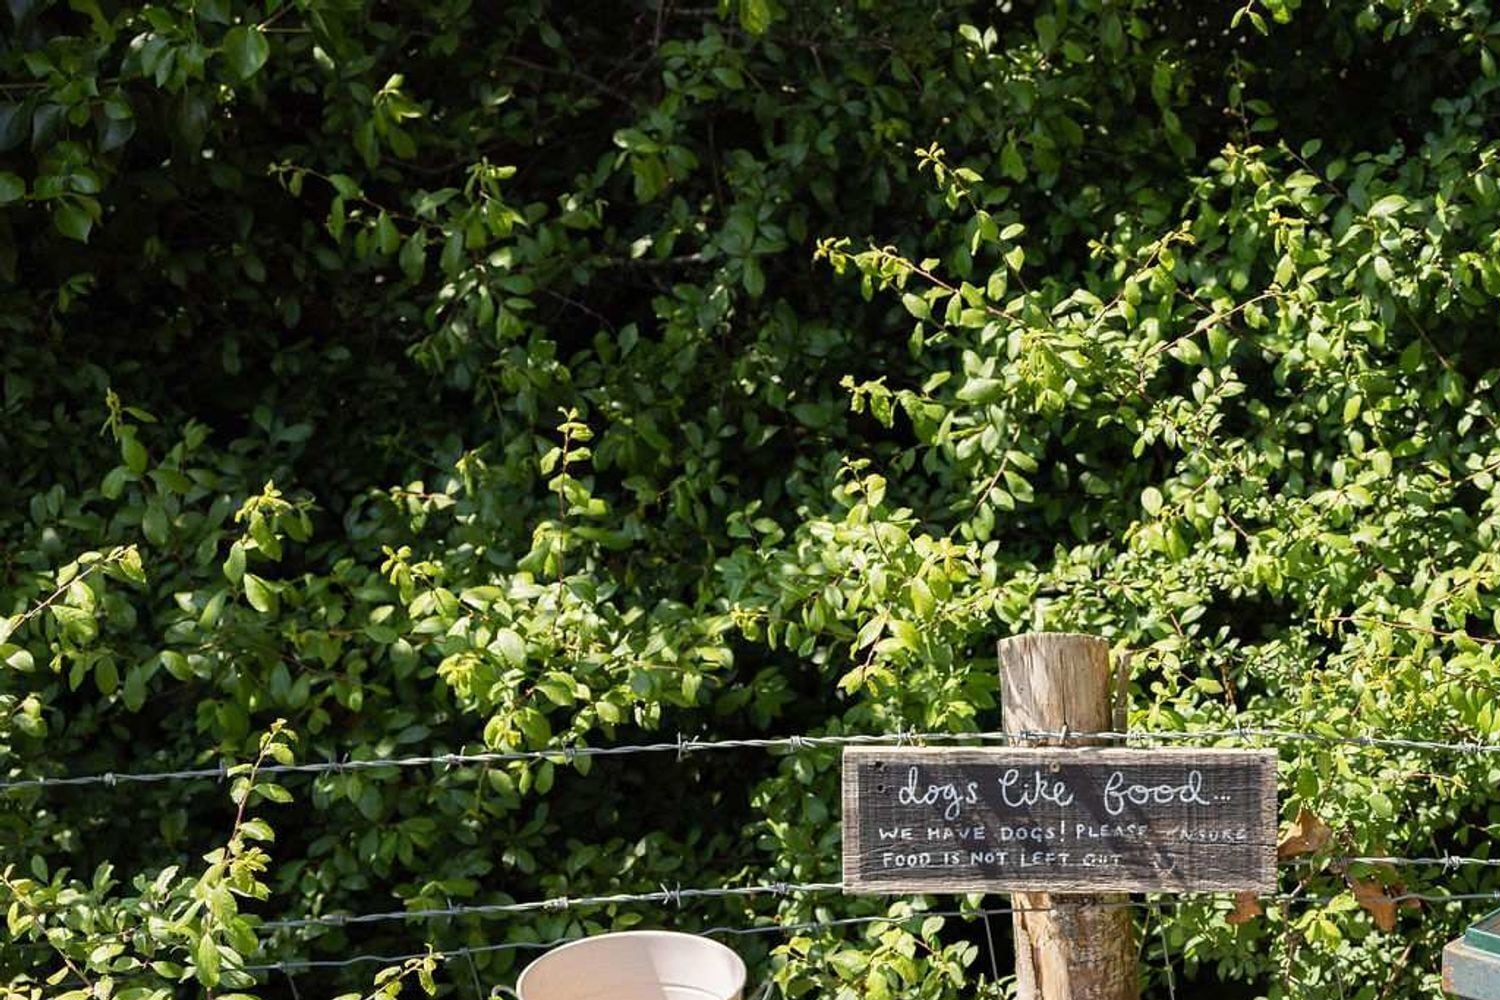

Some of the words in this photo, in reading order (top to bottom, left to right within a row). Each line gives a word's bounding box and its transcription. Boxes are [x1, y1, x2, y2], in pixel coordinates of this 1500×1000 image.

[898, 767, 978, 819] dogs
[998, 768, 1074, 808] like
[879, 827, 912, 841] WE
[928, 826, 985, 840] HAVE
[1001, 821, 1065, 841] DOGS!
[1076, 823, 1147, 840] PLEASE
[884, 853, 930, 867] FOOD
[944, 852, 960, 865] IS
[971, 852, 1008, 865] NOT
[1020, 853, 1069, 867] LEFT
